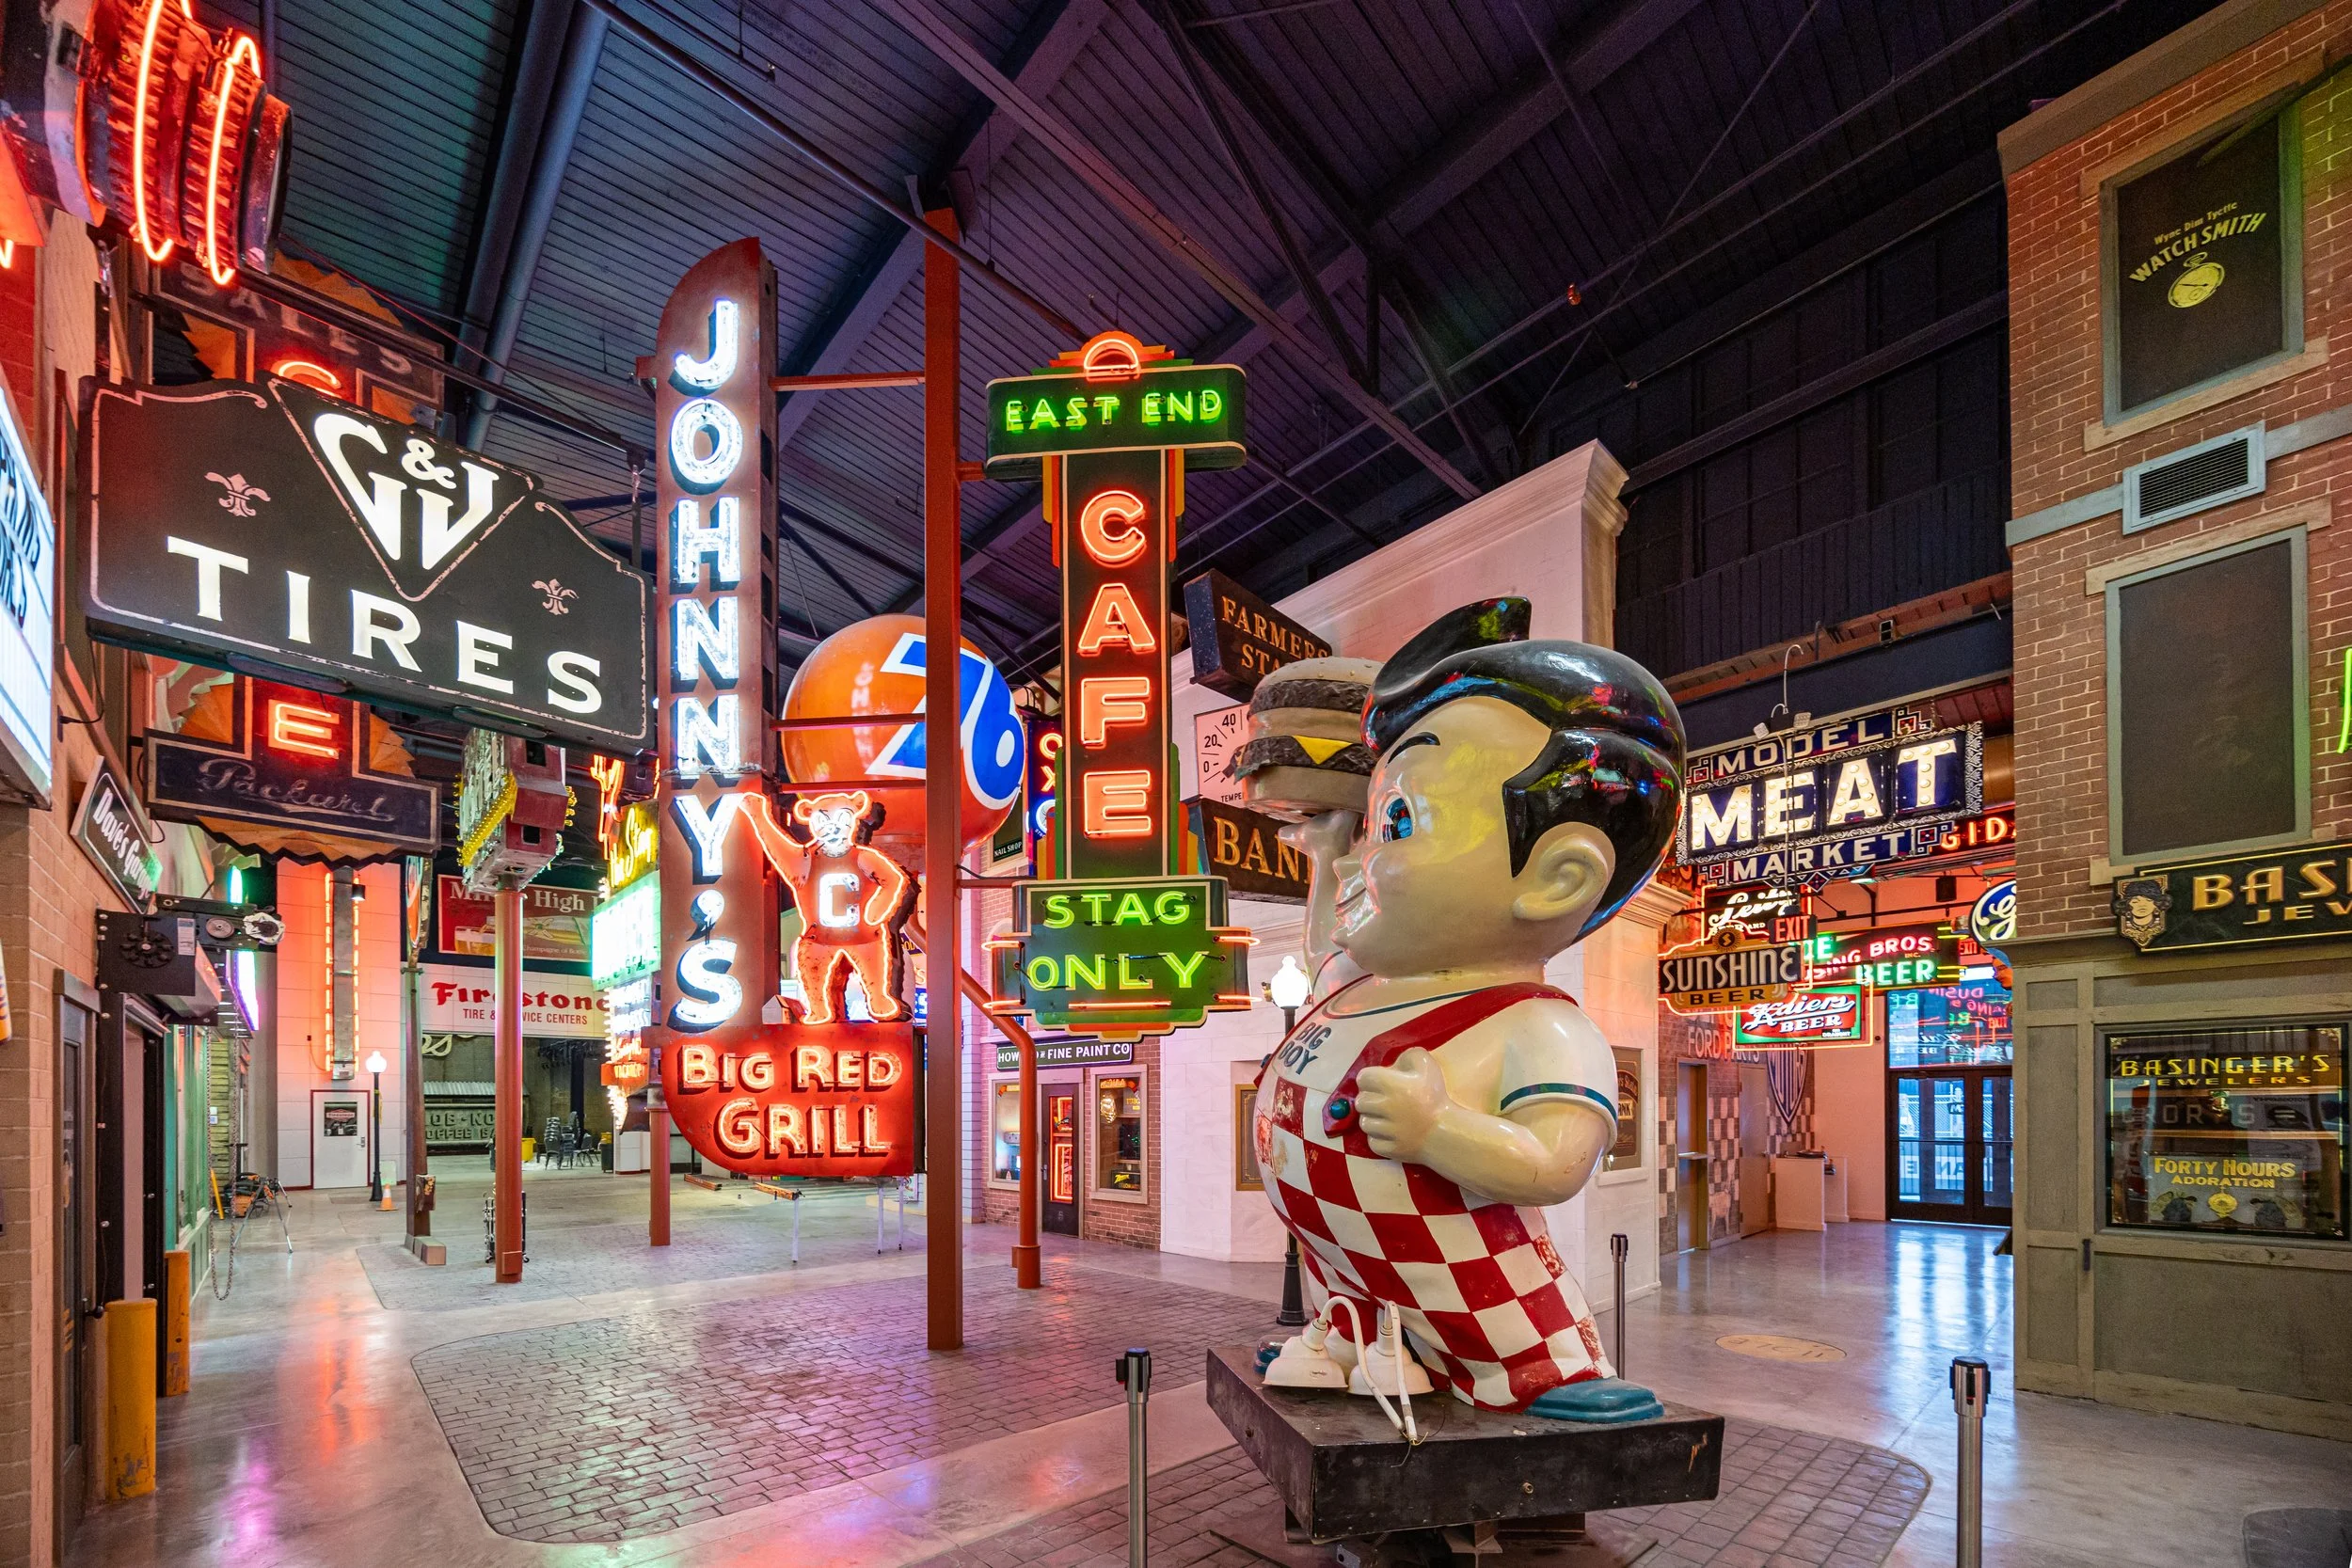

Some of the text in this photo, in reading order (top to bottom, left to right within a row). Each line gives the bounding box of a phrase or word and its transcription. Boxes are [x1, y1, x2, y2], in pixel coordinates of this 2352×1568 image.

[1006, 388, 1223, 433] EAST END
[167, 535, 602, 713] TIRES
[669, 298, 743, 1025] JOHNNY'S
[1078, 490, 1156, 839] CAFE
[1221, 713, 1237, 726] 40
[1204, 735, 1218, 748] 20
[1717, 719, 1885, 777] MODEL
[1202, 760, 1211, 773] 0
[1220, 792, 1244, 803] TEMPE
[1691, 739, 1958, 850] MEAT
[92, 787, 130, 859] Dave's
[993, 841, 1022, 857] NAIL SHOP
[1213, 816, 1312, 887] BAN
[1732, 831, 1907, 881] MARKET
[533, 890, 585, 913] High
[818, 872, 861, 928] C
[1042, 890, 1191, 929] STAG
[1775, 915, 1811, 942] EXIT
[1026, 950, 1210, 992] ONLY
[1661, 945, 1798, 994] SUNSHINE
[1855, 959, 1935, 986] BEER
[431, 982, 612, 1012] Firstone
[1690, 989, 1766, 1006] BEER
[463, 1008, 485, 1020] TIRE
[546, 1014, 588, 1025] CENTERS
[1779, 1014, 1843, 1034] BEER
[1047, 1047, 1073, 1060] FINE
[1075, 1044, 1111, 1059] PAINT
[1112, 1042, 1130, 1055] CO
[1295, 1022, 1332, 1051] BIG
[1688, 1026, 1722, 1058] FORD
[681, 1043, 774, 1091] BIG
[794, 1044, 902, 1089] RED
[1278, 1040, 1319, 1075] BOY
[2121, 1054, 2330, 1077] BASINGER'S
[2137, 1075, 2312, 1086] JEWELERS
[425, 1128, 472, 1140] OFFEE
[717, 1097, 893, 1156] GRILL
[2153, 1157, 2296, 1178] FORTY HOURS
[2171, 1175, 2276, 1189] ADORATION
